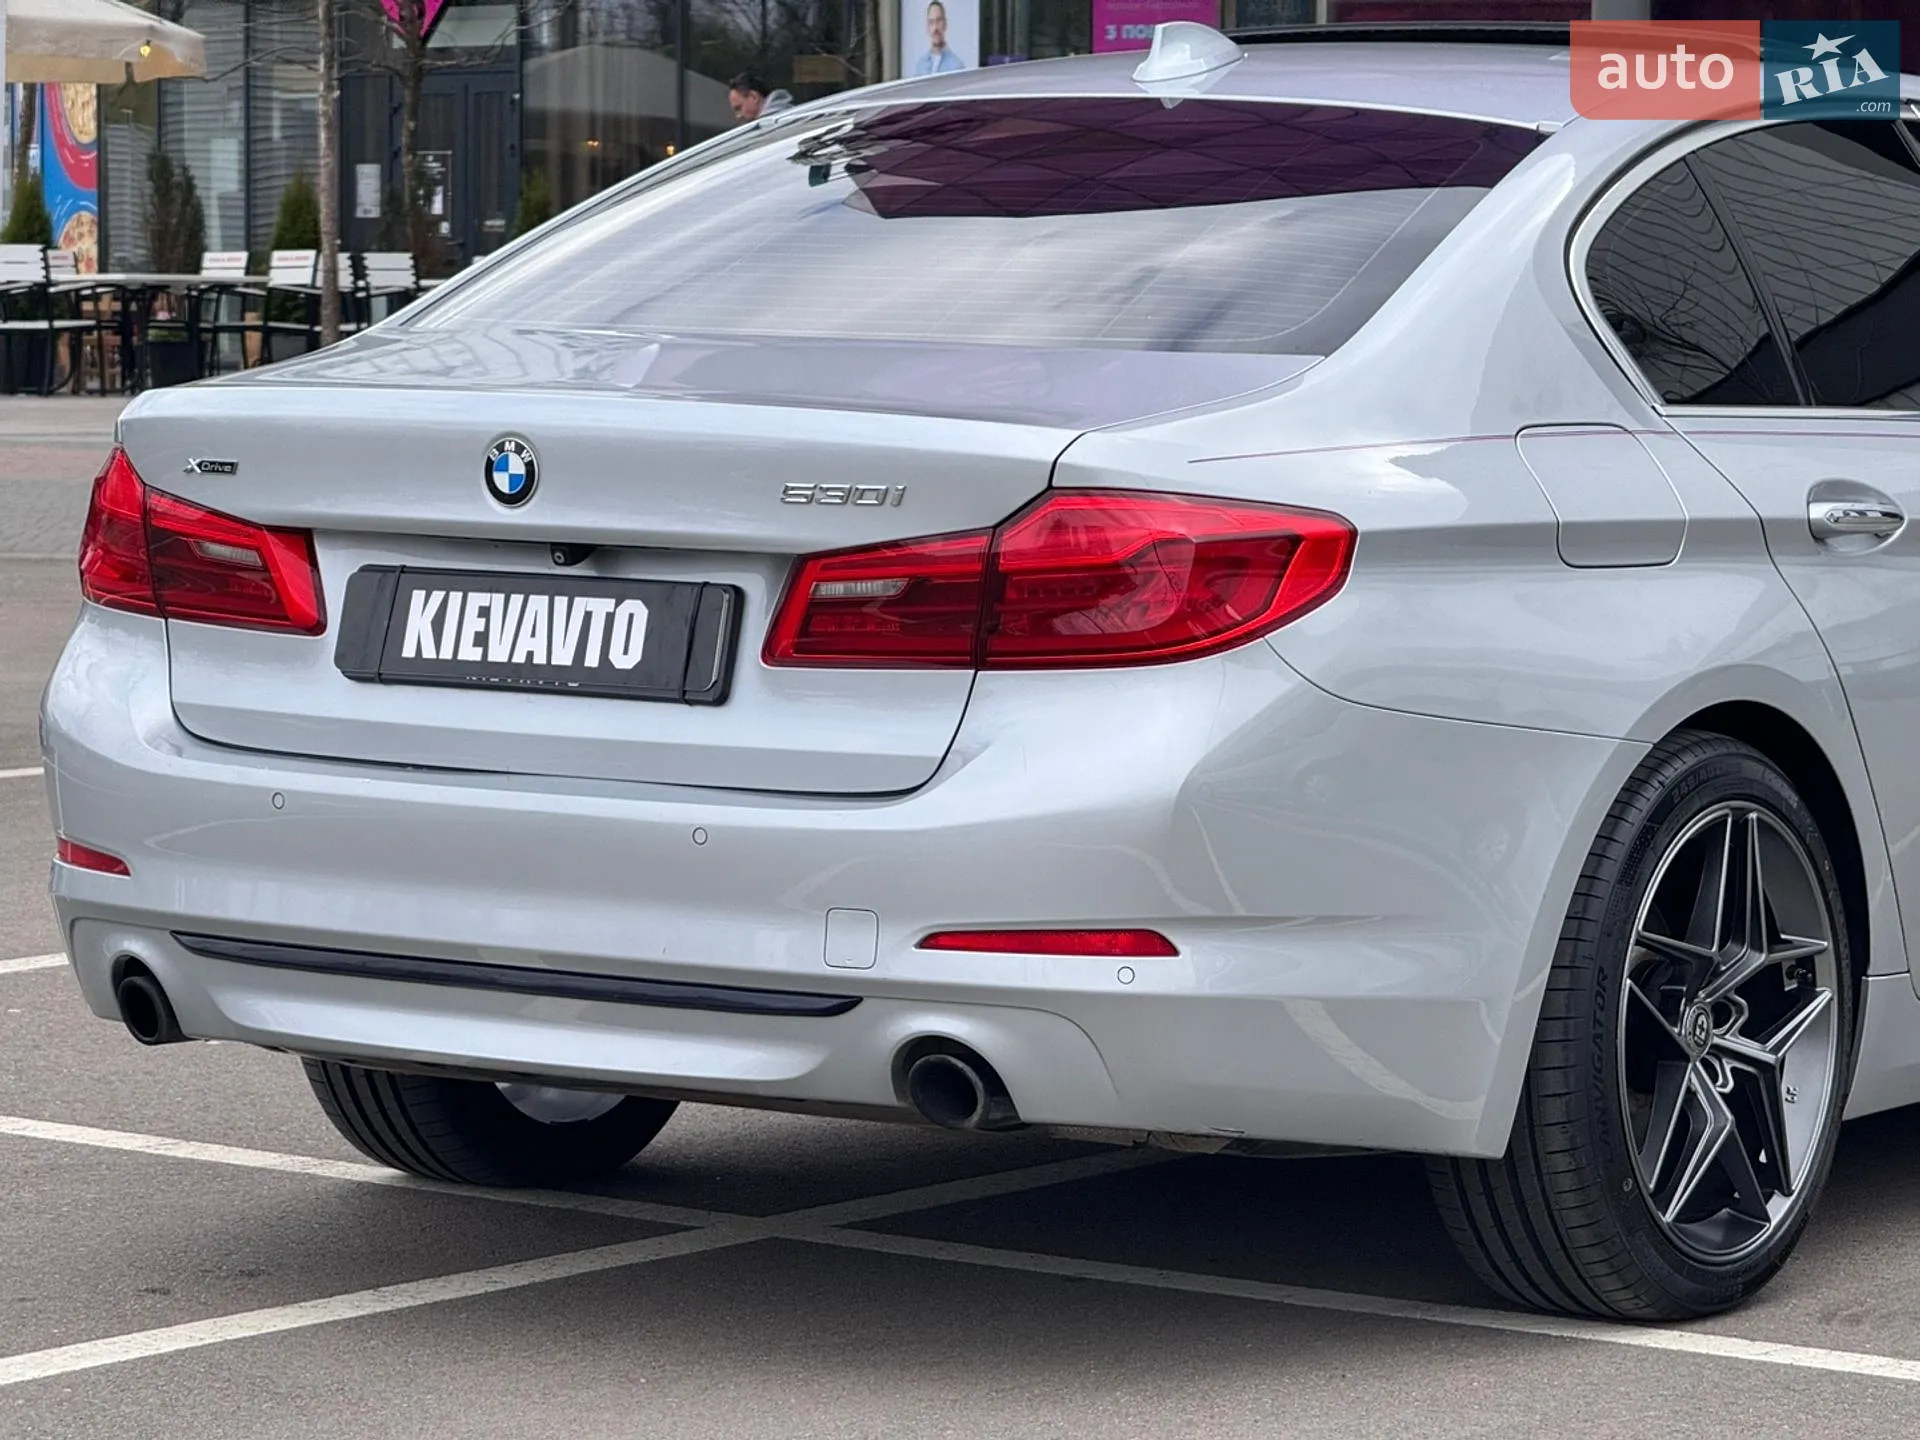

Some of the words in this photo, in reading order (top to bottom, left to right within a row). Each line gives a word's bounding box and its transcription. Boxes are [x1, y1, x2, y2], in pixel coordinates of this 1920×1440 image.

[489, 440, 533, 464] BMW
[781, 482, 906, 507] 530i
[401, 589, 649, 670] KIEVAVTO
[1591, 965, 1613, 1165] LANVIGATOR
